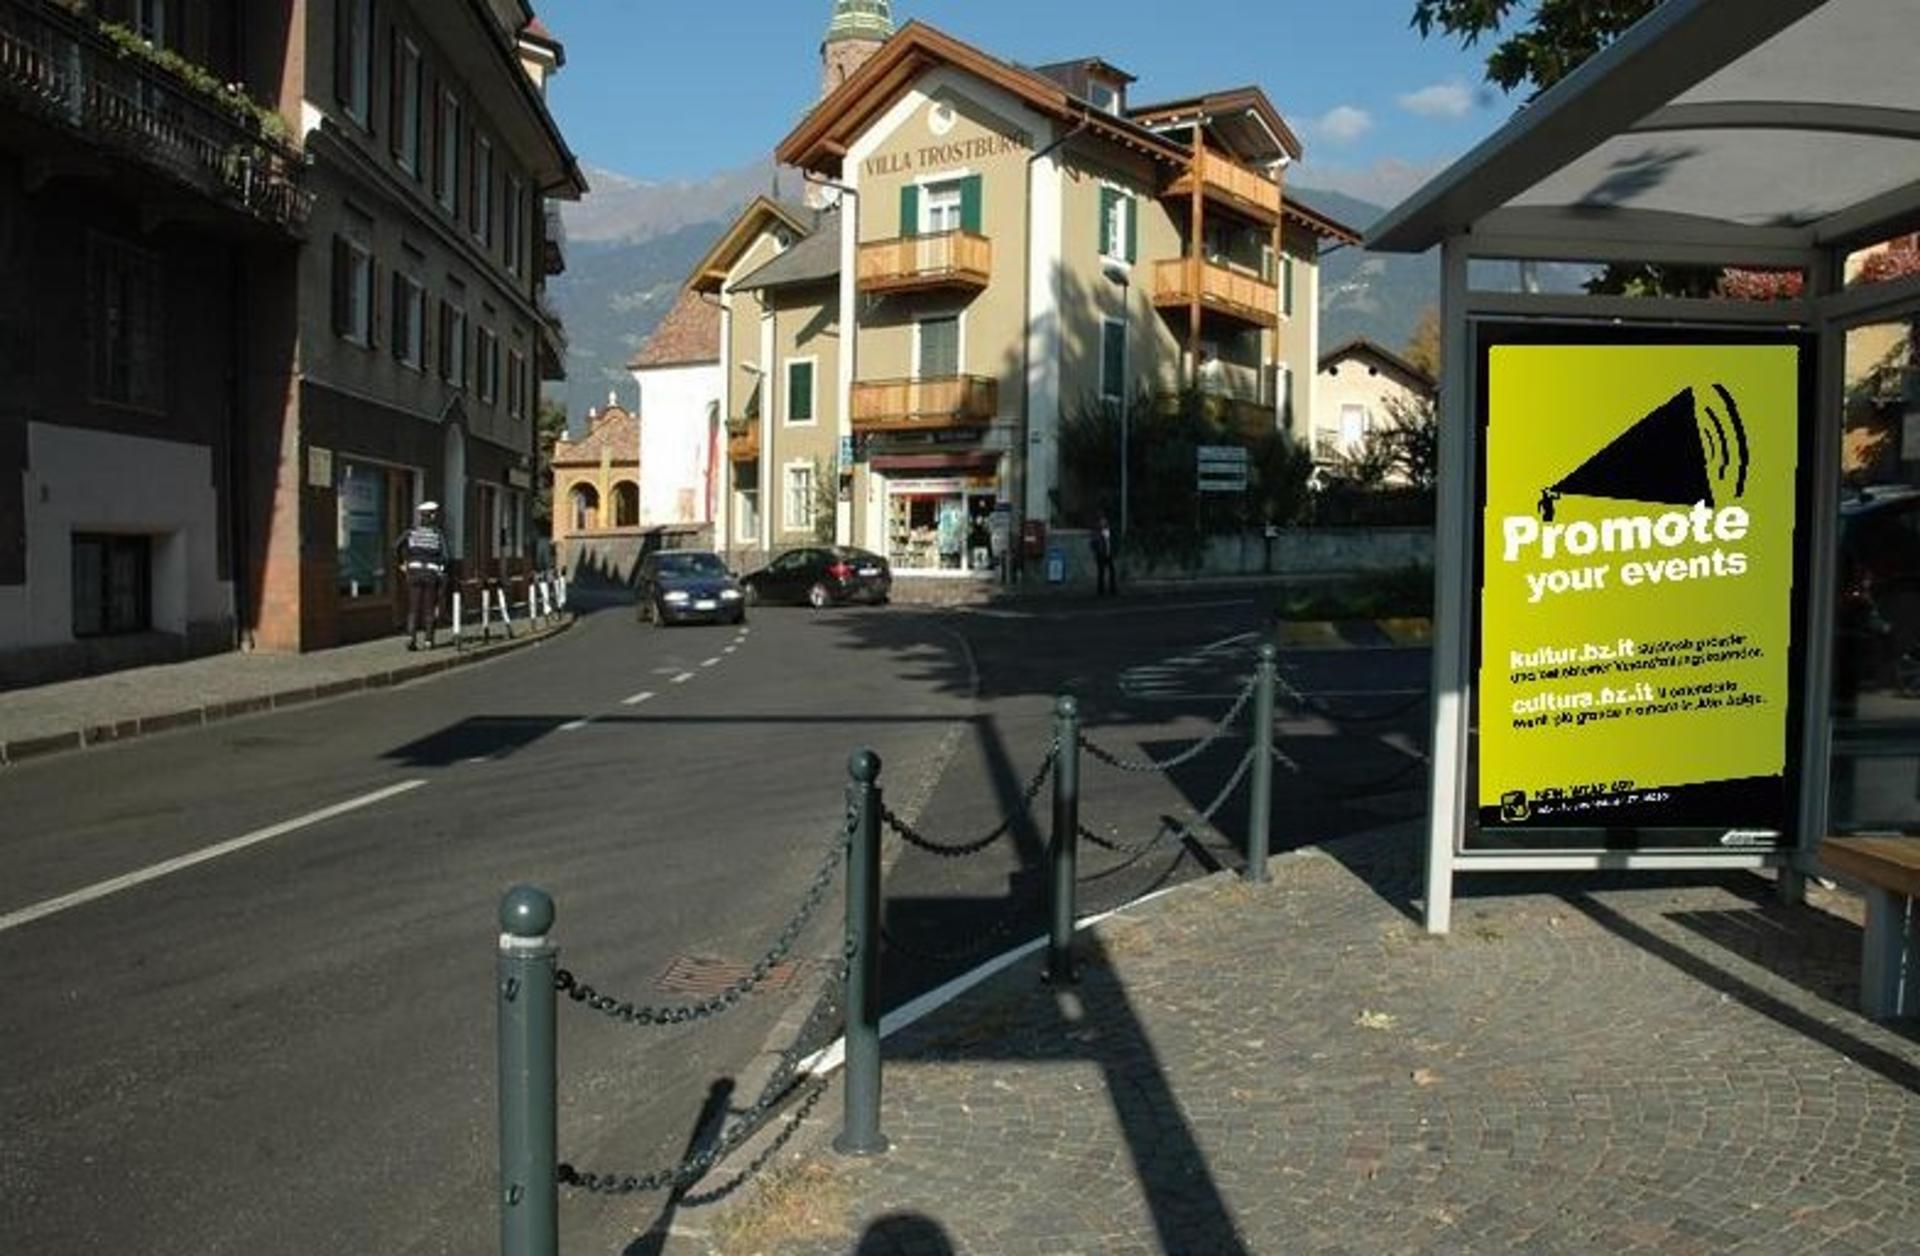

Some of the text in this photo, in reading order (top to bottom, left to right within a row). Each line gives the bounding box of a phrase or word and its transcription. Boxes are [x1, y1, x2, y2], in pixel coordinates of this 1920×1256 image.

[865, 152, 912, 176] VILLA
[1503, 499, 1749, 561] Promote
[1527, 548, 1748, 603] your events
[1510, 638, 1634, 670] kultur.bz.it
[1512, 682, 1654, 713] cultura.bz.it
